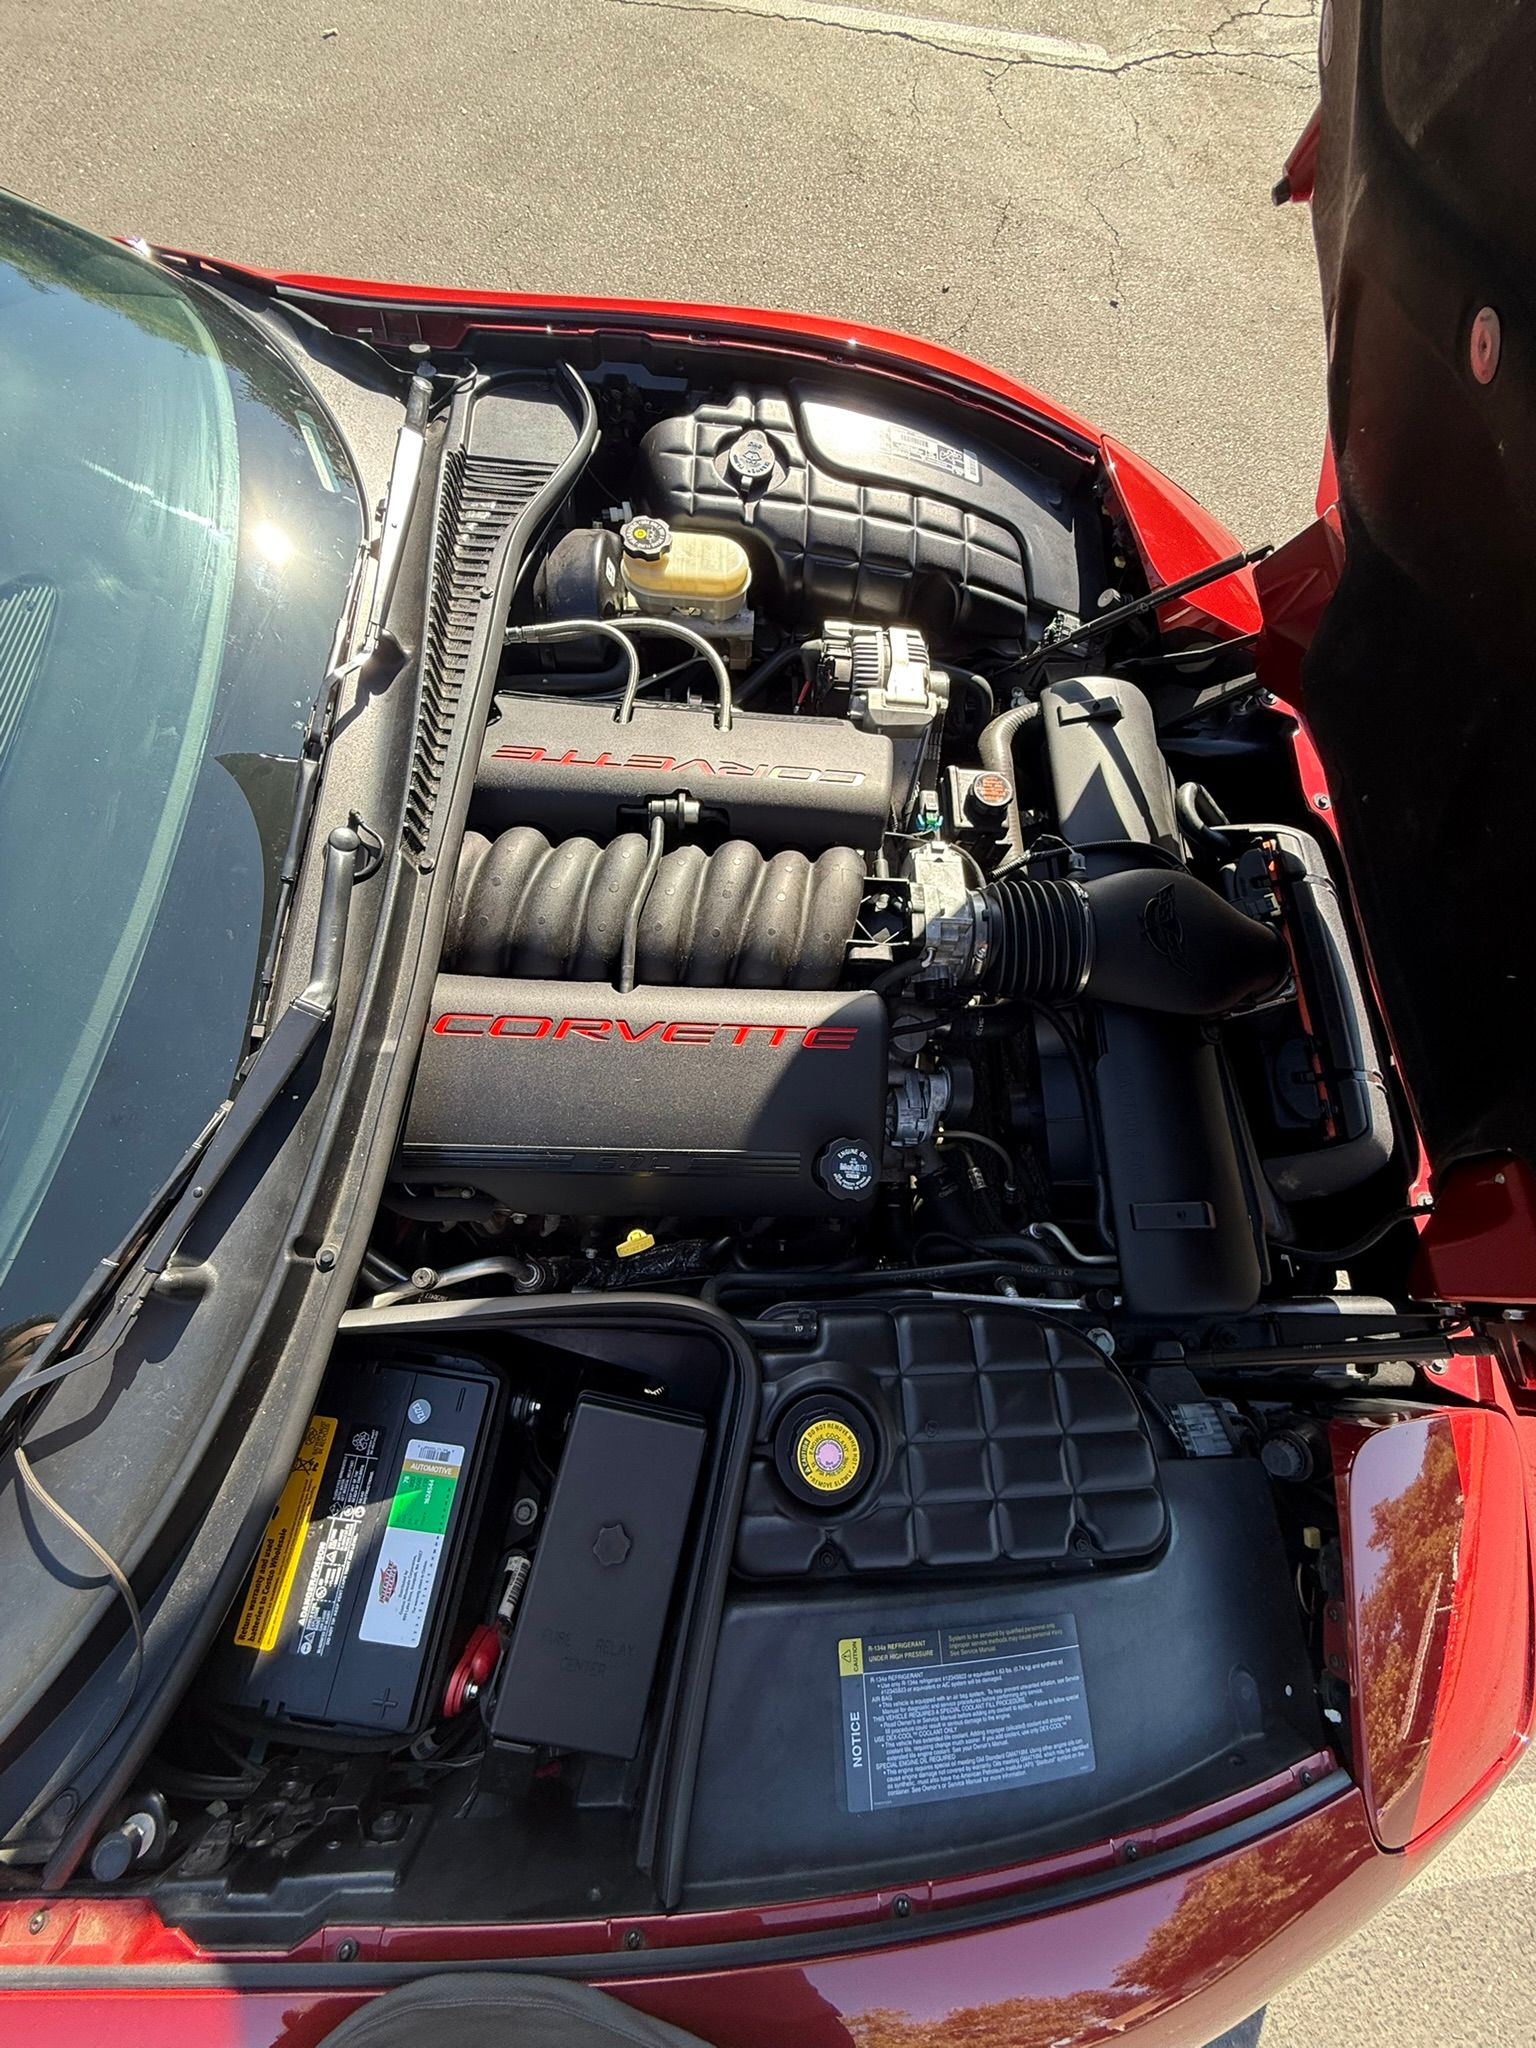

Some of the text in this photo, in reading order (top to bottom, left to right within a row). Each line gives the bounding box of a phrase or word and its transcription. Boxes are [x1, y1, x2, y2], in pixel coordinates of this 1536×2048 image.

[490, 744, 867, 786] CORVETTE
[432, 1012, 858, 1049] CORVETTE
[808, 1429, 816, 1437] DO
[815, 1423, 826, 1431] NOT
[827, 1423, 849, 1437] REMOVE
[410, 1463, 452, 1475] AUTOMOTIVE
[801, 1439, 810, 1468] CAUTION
[268, 1526, 288, 1569] Wholesale
[238, 1537, 274, 1640] Return warranty and used
[261, 1568, 275, 1595] Costco
[300, 1540, 327, 1619] DANGER/POISON
[378, 1560, 394, 1603] INTERSTATE
[383, 1564, 398, 1602] BATTERIES
[258, 1595, 267, 1605] to
[247, 1605, 264, 1642] batteries
[595, 1637, 636, 1657] RELAY
[868, 1654, 888, 1662] UNDER
[904, 1649, 934, 1658] PRESSURE
[850, 1711, 863, 1767] NOTICE
